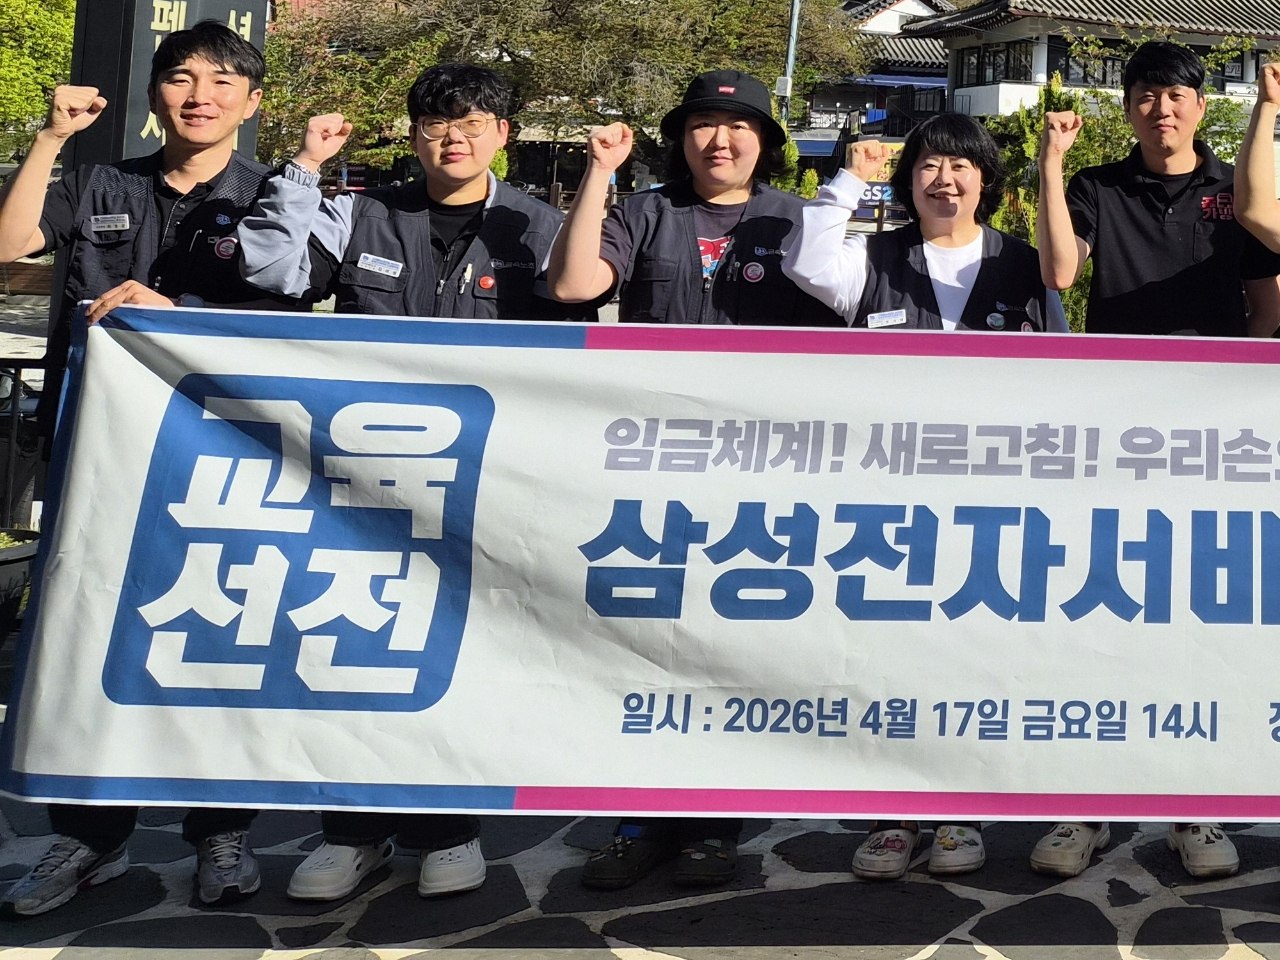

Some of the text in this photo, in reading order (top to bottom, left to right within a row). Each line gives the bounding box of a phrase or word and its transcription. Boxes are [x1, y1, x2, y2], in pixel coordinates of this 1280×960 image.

[861, 186, 892, 200] GS2
[167, 397, 462, 539] 교육
[604, 418, 848, 473] 임금체계!
[861, 422, 1100, 479] 새로고침!
[137, 542, 441, 694] 선전
[622, 693, 691, 734] 일시
[724, 698, 848, 737] 2026년
[860, 698, 917, 739] 4월
[932, 699, 1009, 740] 17일
[1023, 700, 1127, 742] 금요일
[1143, 701, 1218, 741] 14시
